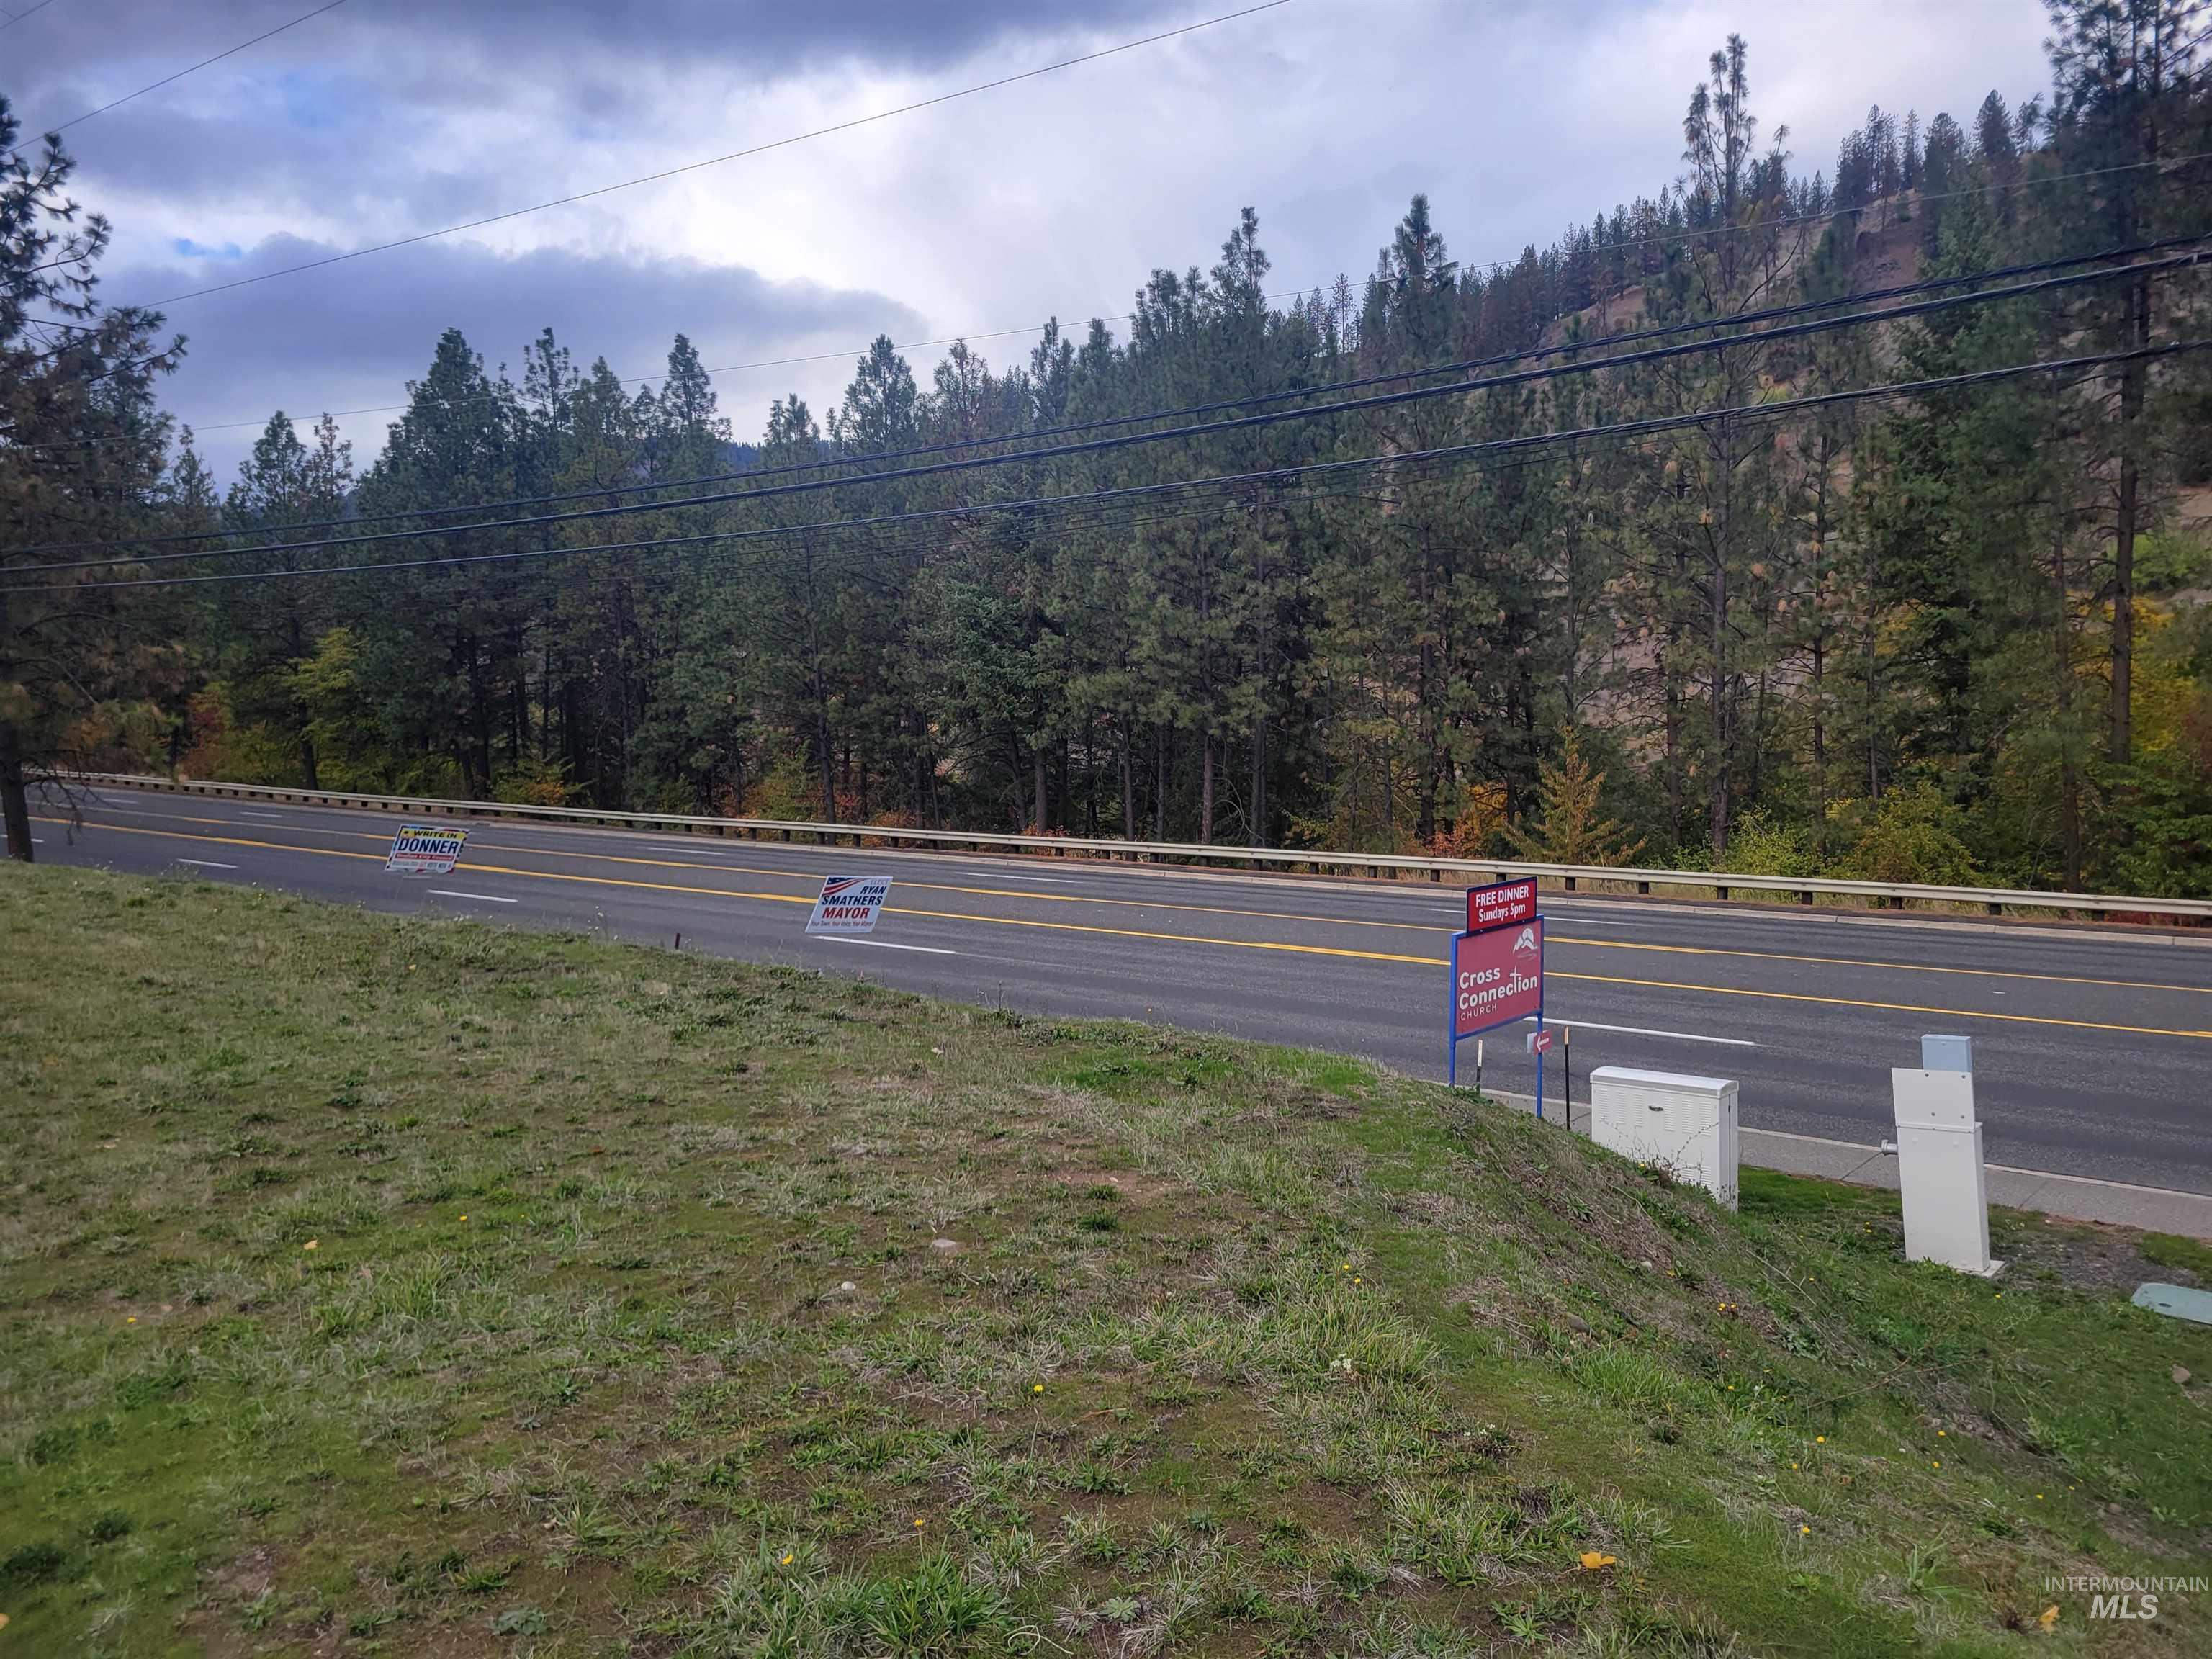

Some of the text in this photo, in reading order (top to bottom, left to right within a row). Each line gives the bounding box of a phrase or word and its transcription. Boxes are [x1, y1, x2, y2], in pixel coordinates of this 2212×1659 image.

[398, 838, 459, 854] DONNER
[822, 896, 883, 905] SMATHERS
[1475, 885, 1529, 907] FREE DINNER
[822, 907, 871, 919] MAYOR
[1478, 902, 1526, 922] Sundays 5pm
[1460, 967, 1501, 989] Cross
[1459, 966, 1538, 1010] Connection
[1460, 1003, 1498, 1021] CHURCH
